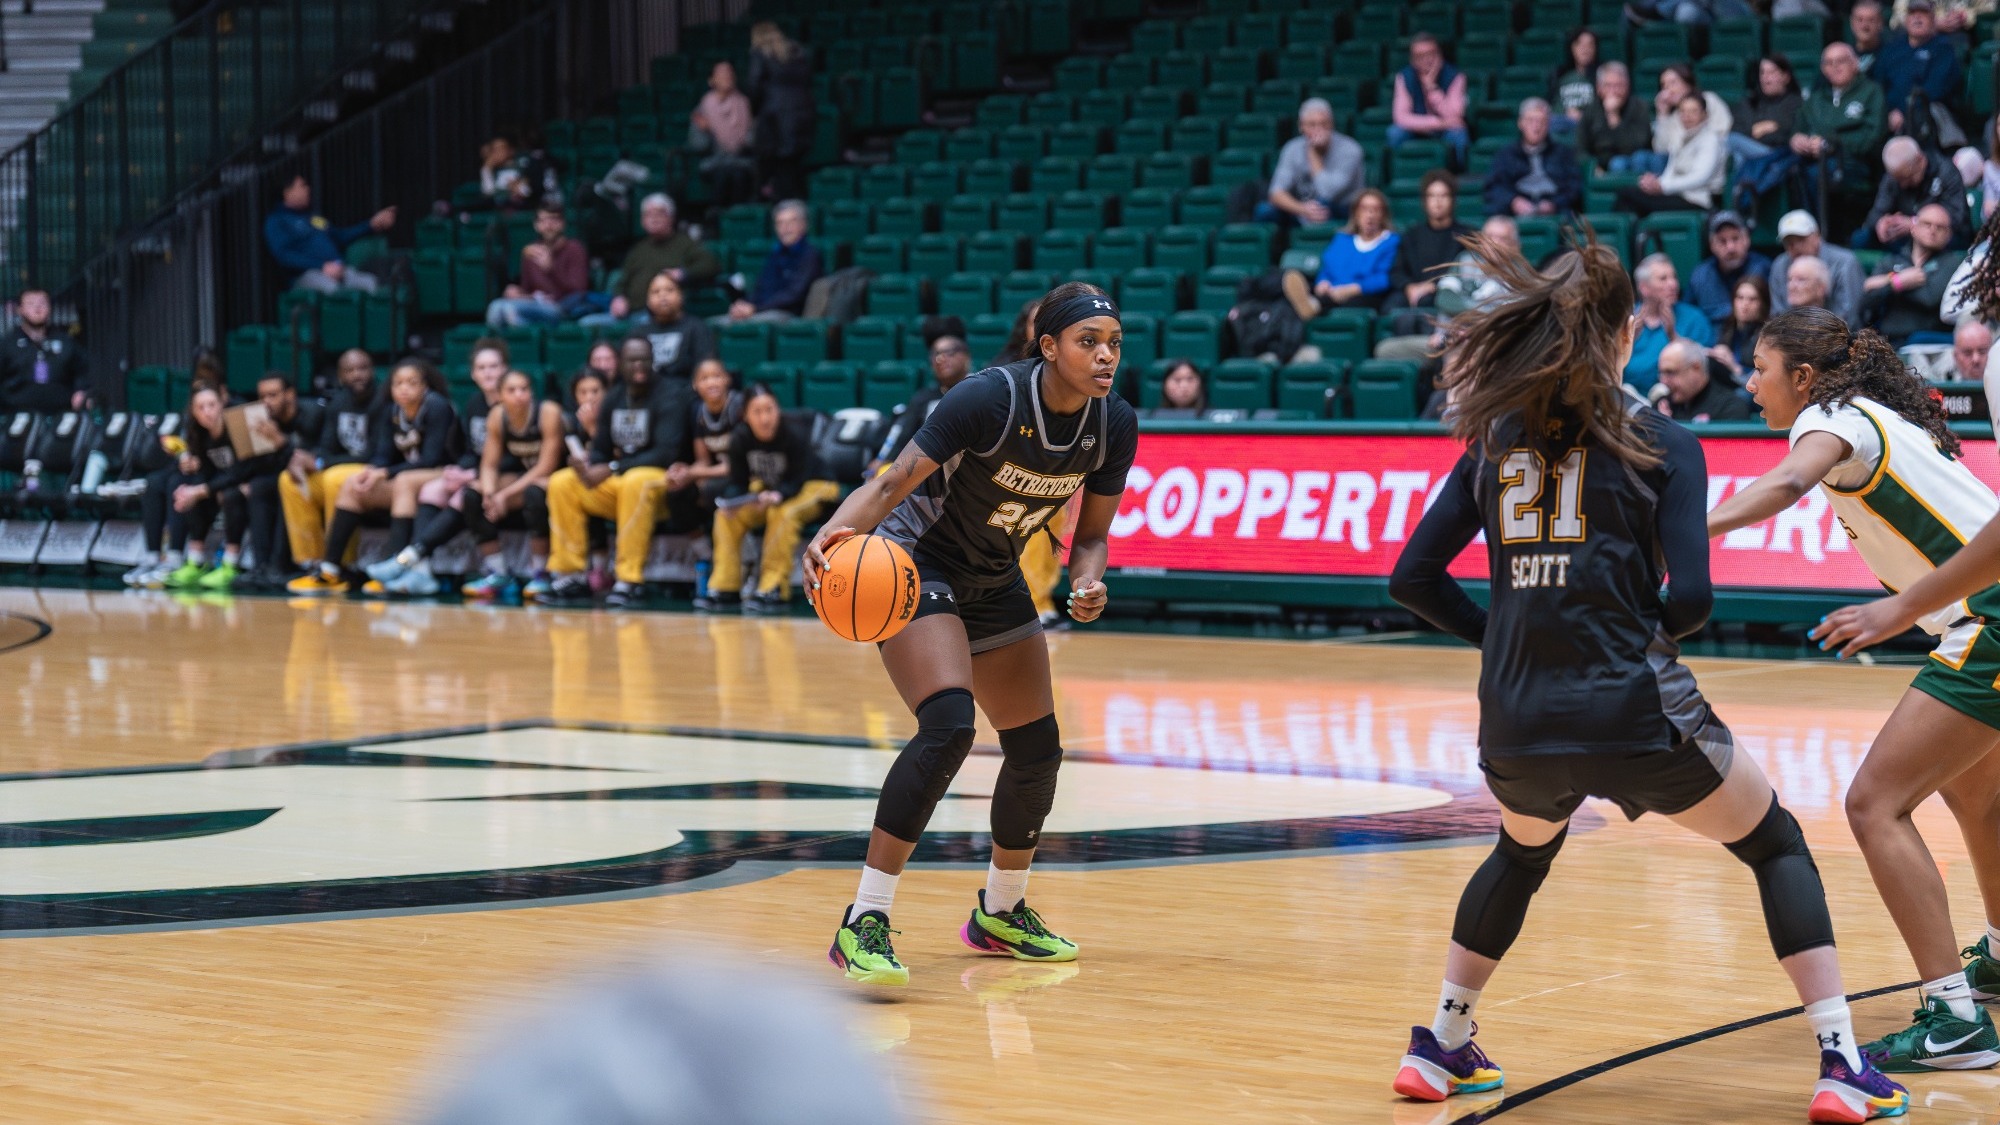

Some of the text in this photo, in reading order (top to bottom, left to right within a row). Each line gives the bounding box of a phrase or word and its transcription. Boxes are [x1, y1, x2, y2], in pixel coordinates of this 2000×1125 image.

[987, 501, 1055, 537] 24
[1108, 465, 1490, 552] COPPERT
[1499, 448, 1587, 544] 21
[899, 566, 916, 620] NCAA
[1511, 553, 1571, 589] SCOTT
